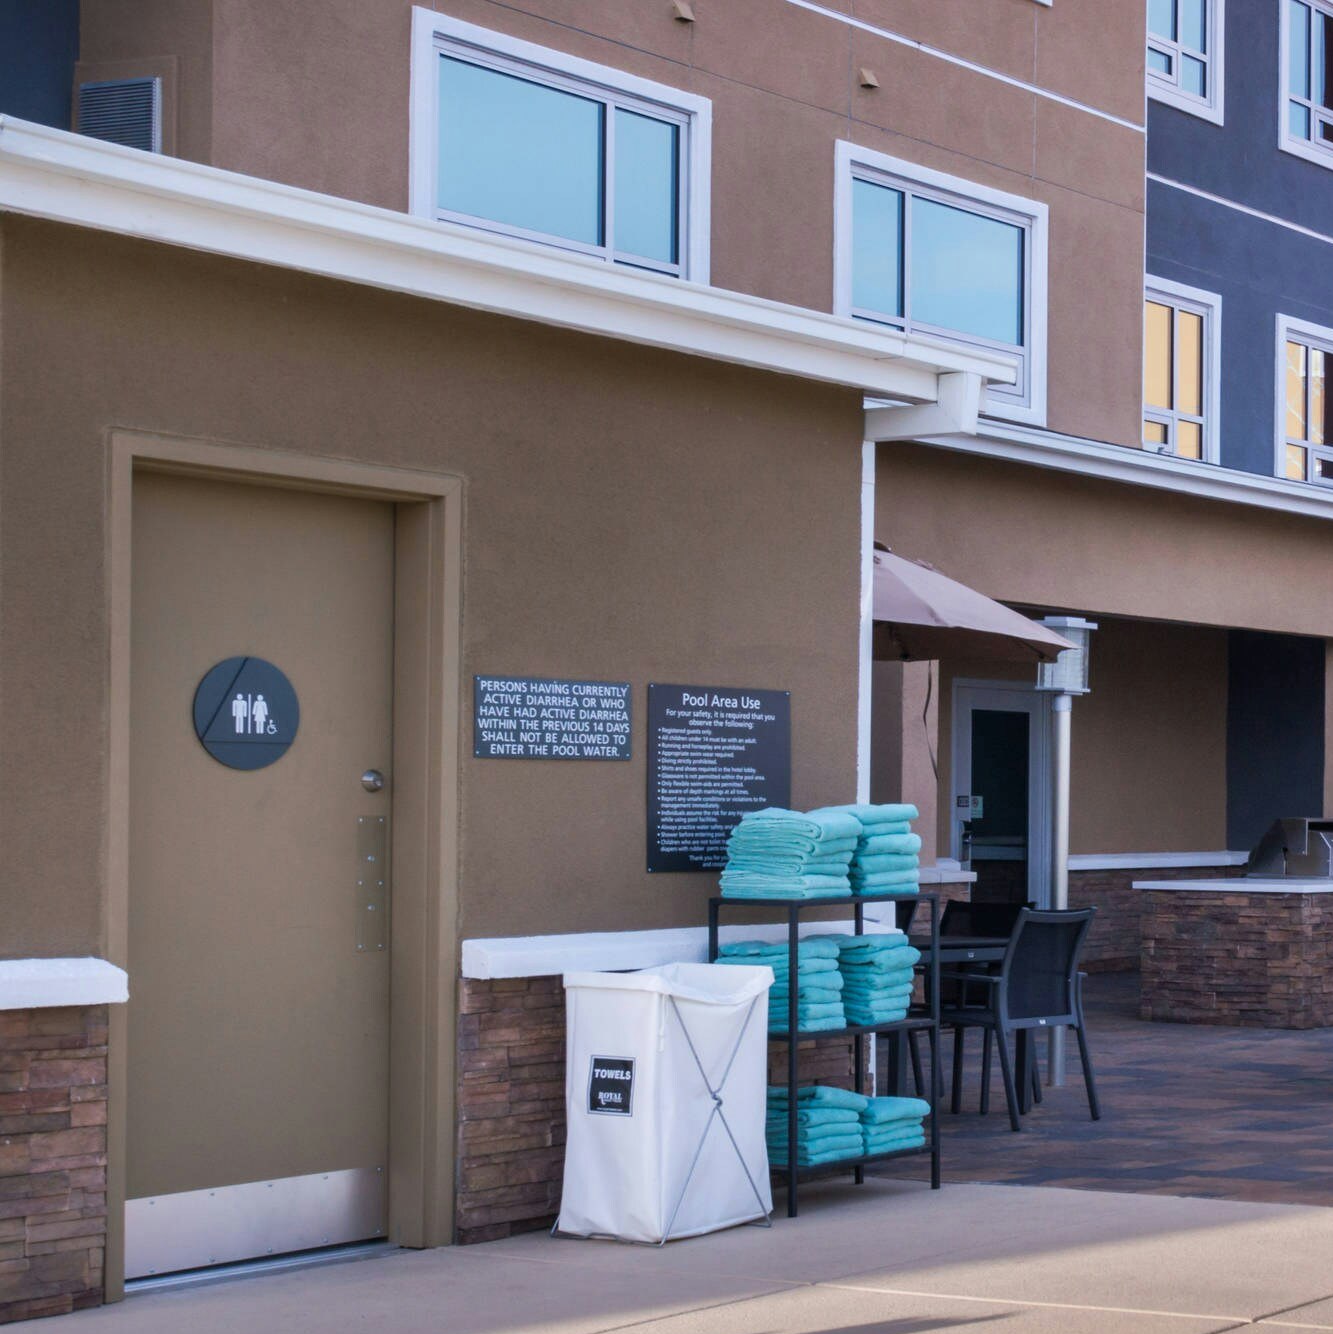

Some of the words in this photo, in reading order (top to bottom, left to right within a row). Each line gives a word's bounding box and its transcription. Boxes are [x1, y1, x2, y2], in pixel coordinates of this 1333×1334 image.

[481, 681, 527, 692] PERSONS
[530, 683, 569, 694] HAVING
[572, 684, 627, 697] CURRENTLY
[484, 694, 521, 704] ACTIVE
[527, 695, 579, 707] DIARRHEA
[583, 698, 596, 707] OR
[600, 699, 624, 709] WHO
[682, 693, 707, 706] Pool
[711, 695, 737, 708] Area
[741, 696, 760, 709] Use
[480, 706, 509, 716] HAVE
[514, 708, 536, 717] HAD
[540, 708, 575, 719] ACTIVE
[580, 710, 628, 720] DIARRHEA
[693, 710, 712, 719] safety,
[478, 718, 516, 729] WITHIN
[520, 720, 539, 730] THE
[543, 721, 590, 732] PREVIOUS
[593, 722, 603, 732] 14
[607, 723, 629, 733] DAYS
[482, 731, 515, 742] SHALL
[520, 732, 541, 742] NOT
[546, 733, 557, 743] BE
[562, 734, 609, 744] ALLOWED
[613, 735, 625, 744] TO
[491, 744, 524, 754] ENTER
[528, 745, 548, 755] THE
[553, 745, 580, 756] POOL
[584, 746, 620, 756] WATER.
[595, 1069, 631, 1080] TOWELS
